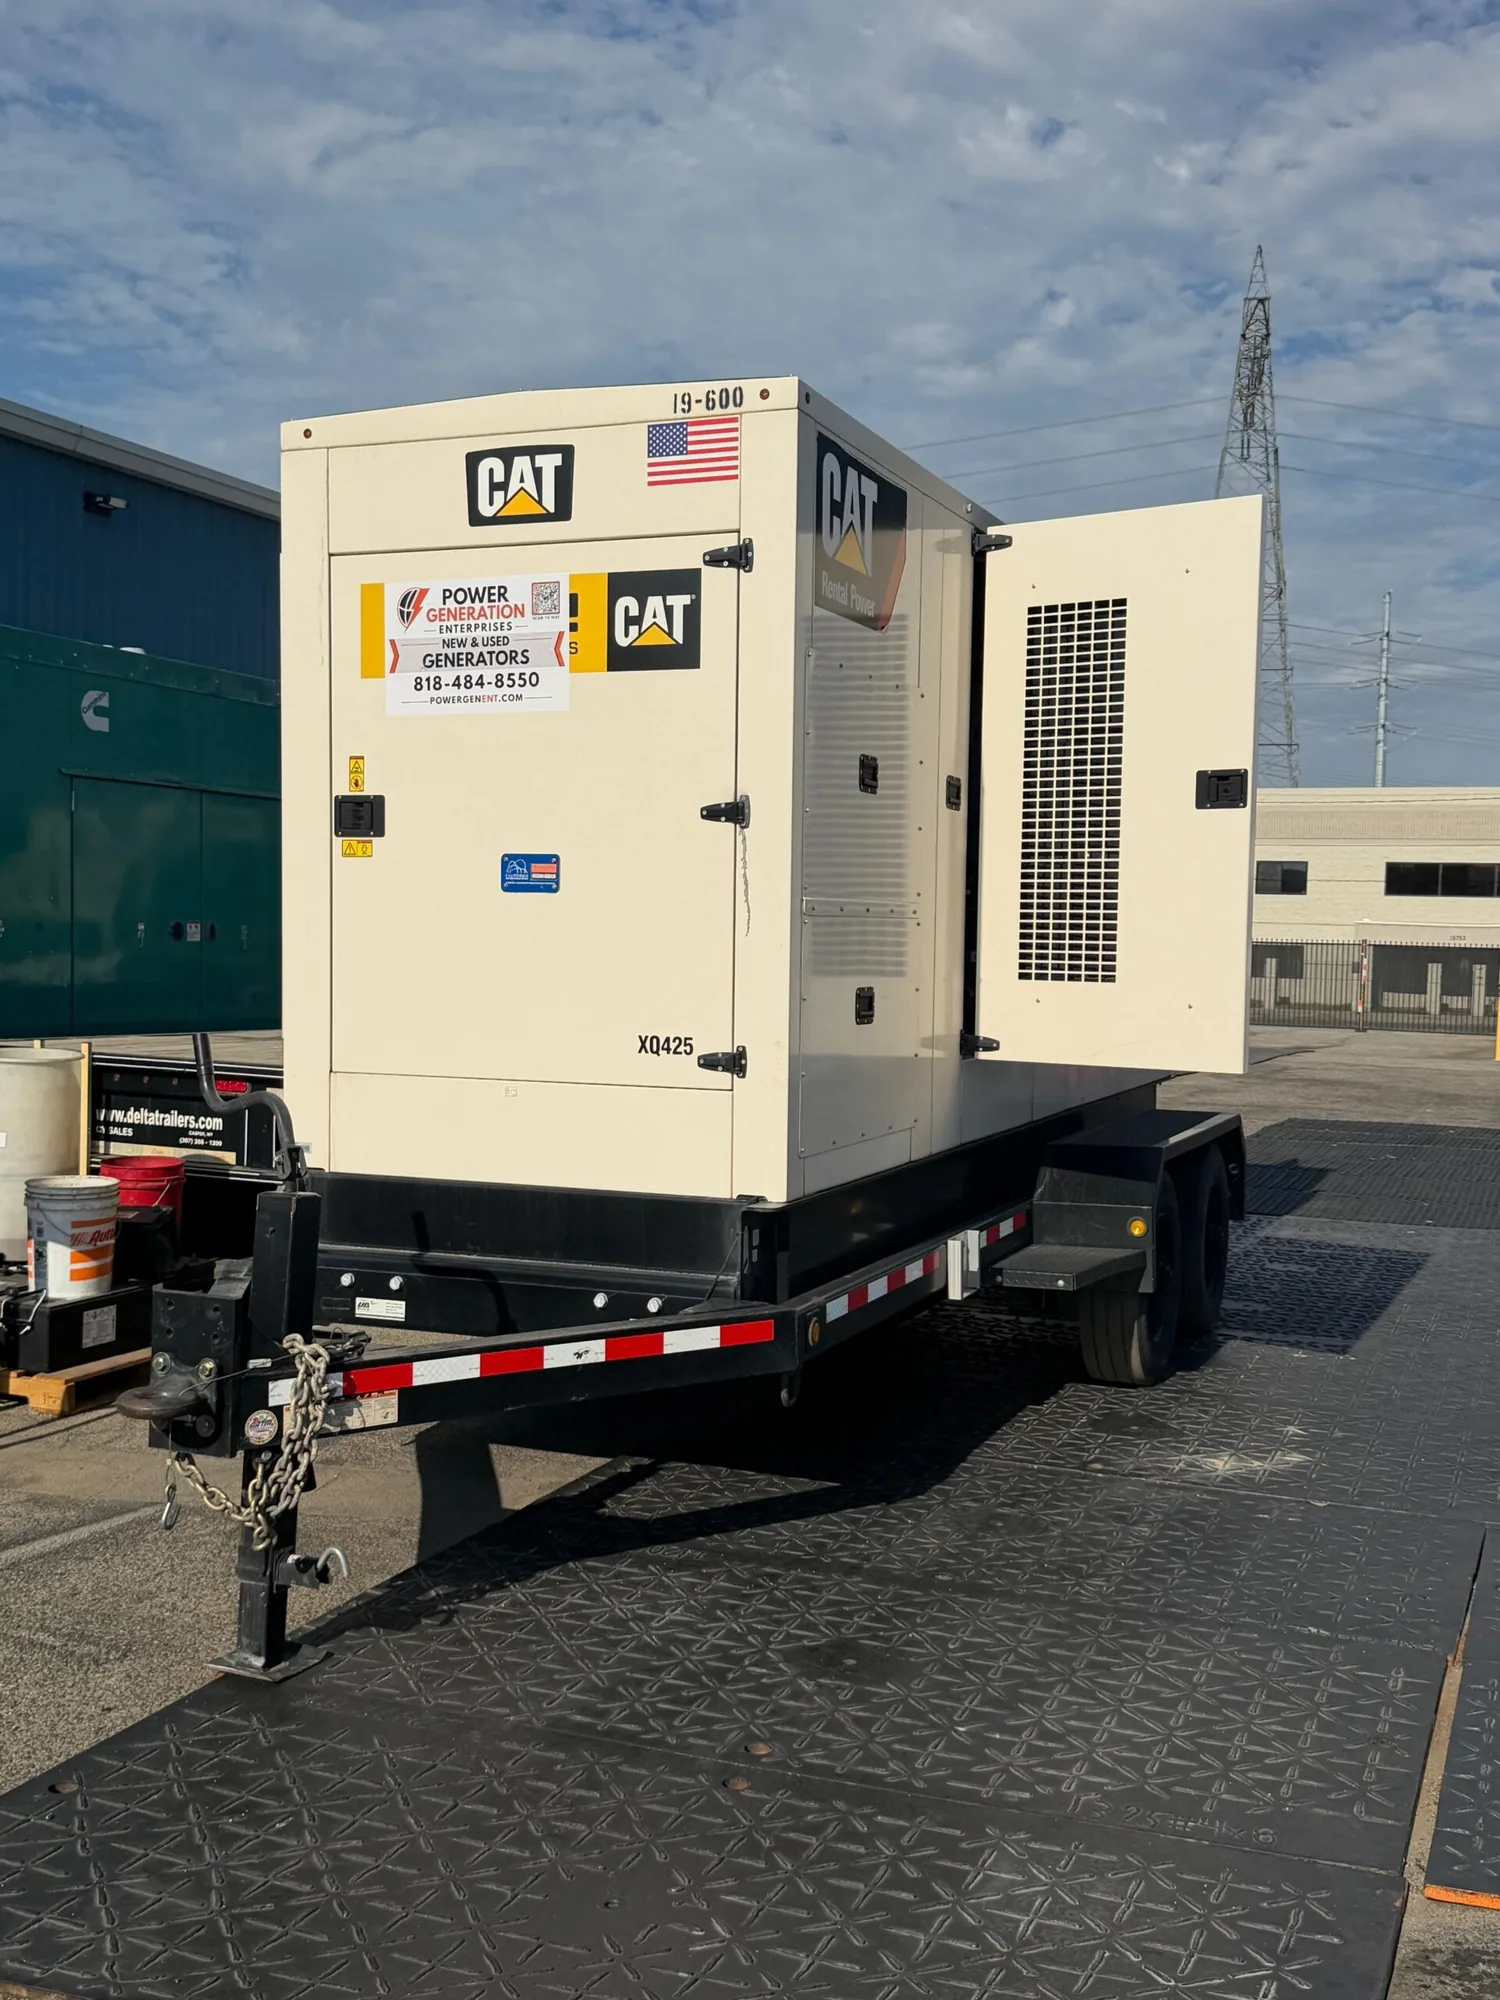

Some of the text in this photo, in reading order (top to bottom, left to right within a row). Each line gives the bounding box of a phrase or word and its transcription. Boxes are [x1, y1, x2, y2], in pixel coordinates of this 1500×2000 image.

[673, 386, 744, 414] 19-600
[478, 453, 562, 517] CAT
[822, 452, 878, 578] CAT
[442, 585, 509, 605] POWER
[821, 571, 876, 618] Rental Power
[426, 603, 525, 623] GENERATION
[614, 594, 691, 647] CAT
[439, 622, 513, 634] ENTERPRISES
[442, 635, 510, 649] NEW & USED
[422, 649, 530, 669] GENERATORS
[413, 671, 540, 692] 818-484-8550
[429, 693, 524, 705] POWERGENENT.COM
[637, 1035, 694, 1057] XQ425
[95, 1106, 223, 1131] www.deltatrailers.com
[109, 1126, 133, 1137] SALES
